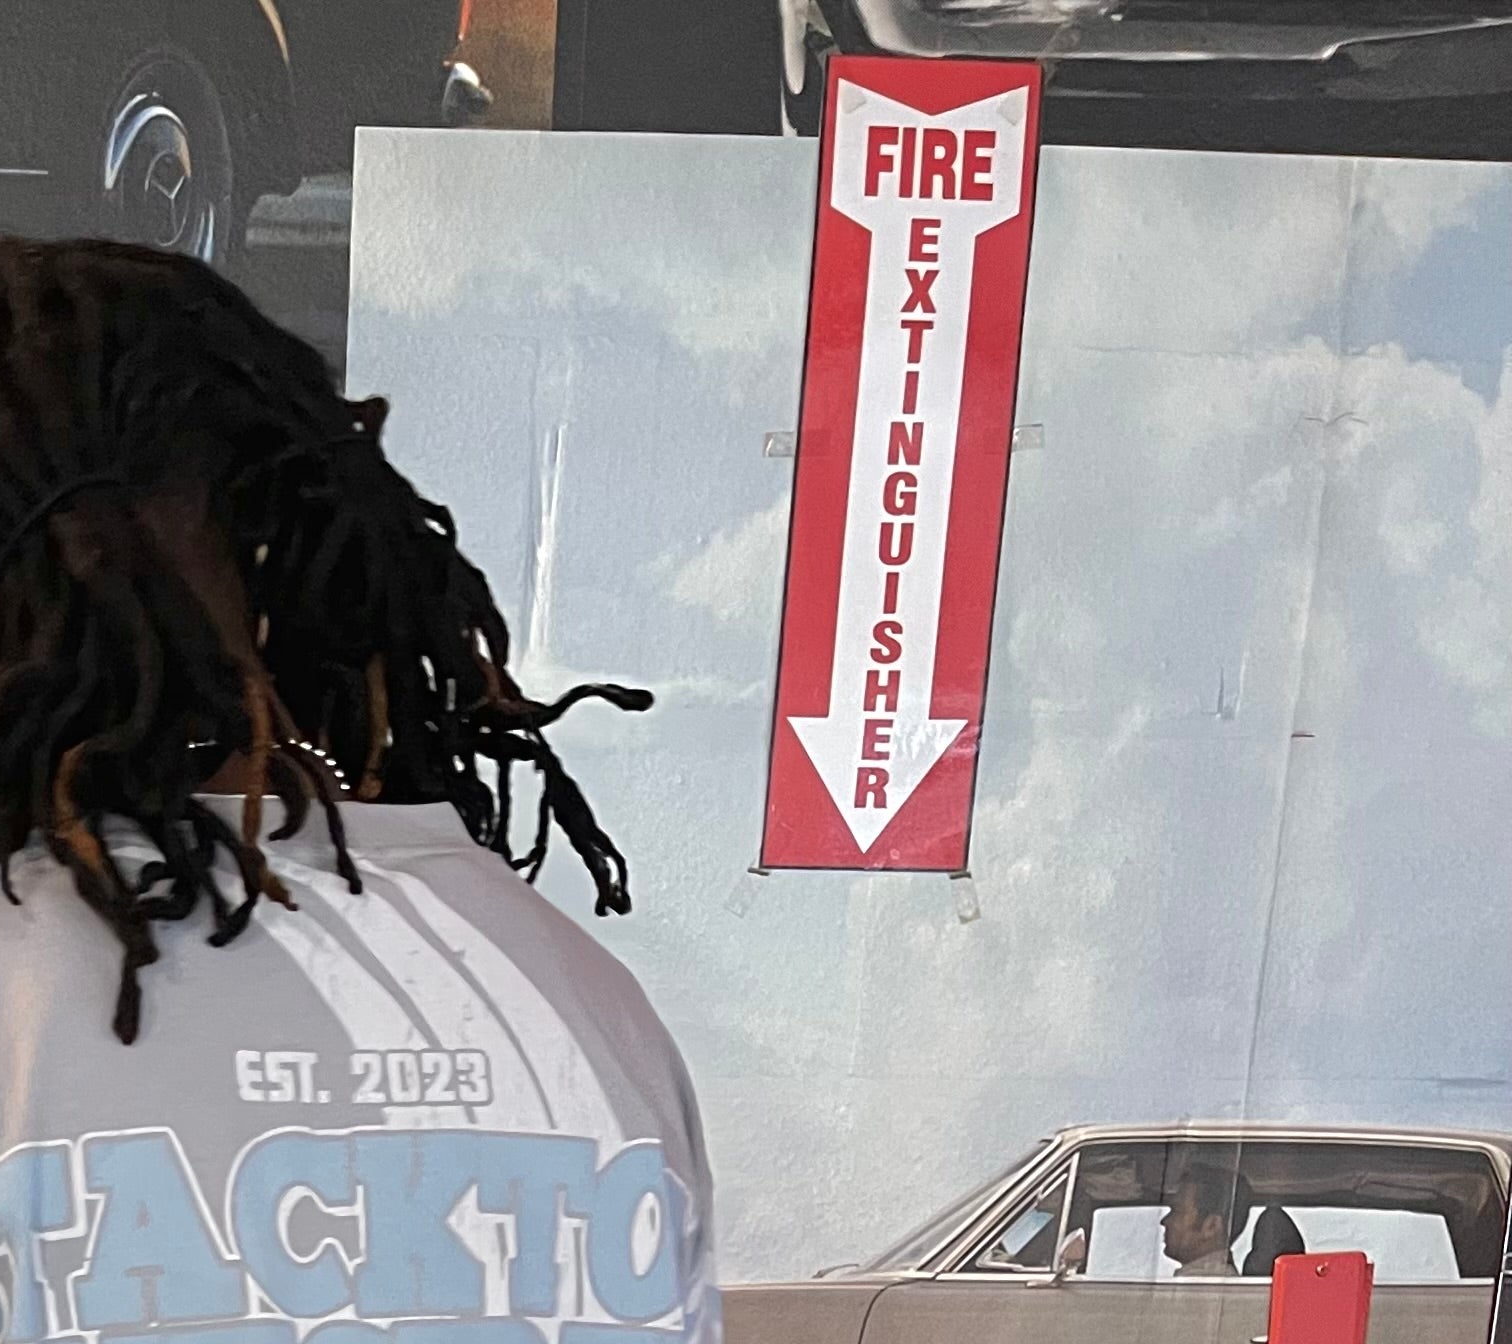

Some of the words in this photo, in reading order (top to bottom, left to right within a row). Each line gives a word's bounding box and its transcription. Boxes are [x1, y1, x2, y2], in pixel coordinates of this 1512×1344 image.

[864, 125, 997, 201] FIRE
[854, 217, 943, 810] EXTINGUISHER
[235, 1049, 330, 1103] EST.
[350, 1050, 492, 1106] 2023
